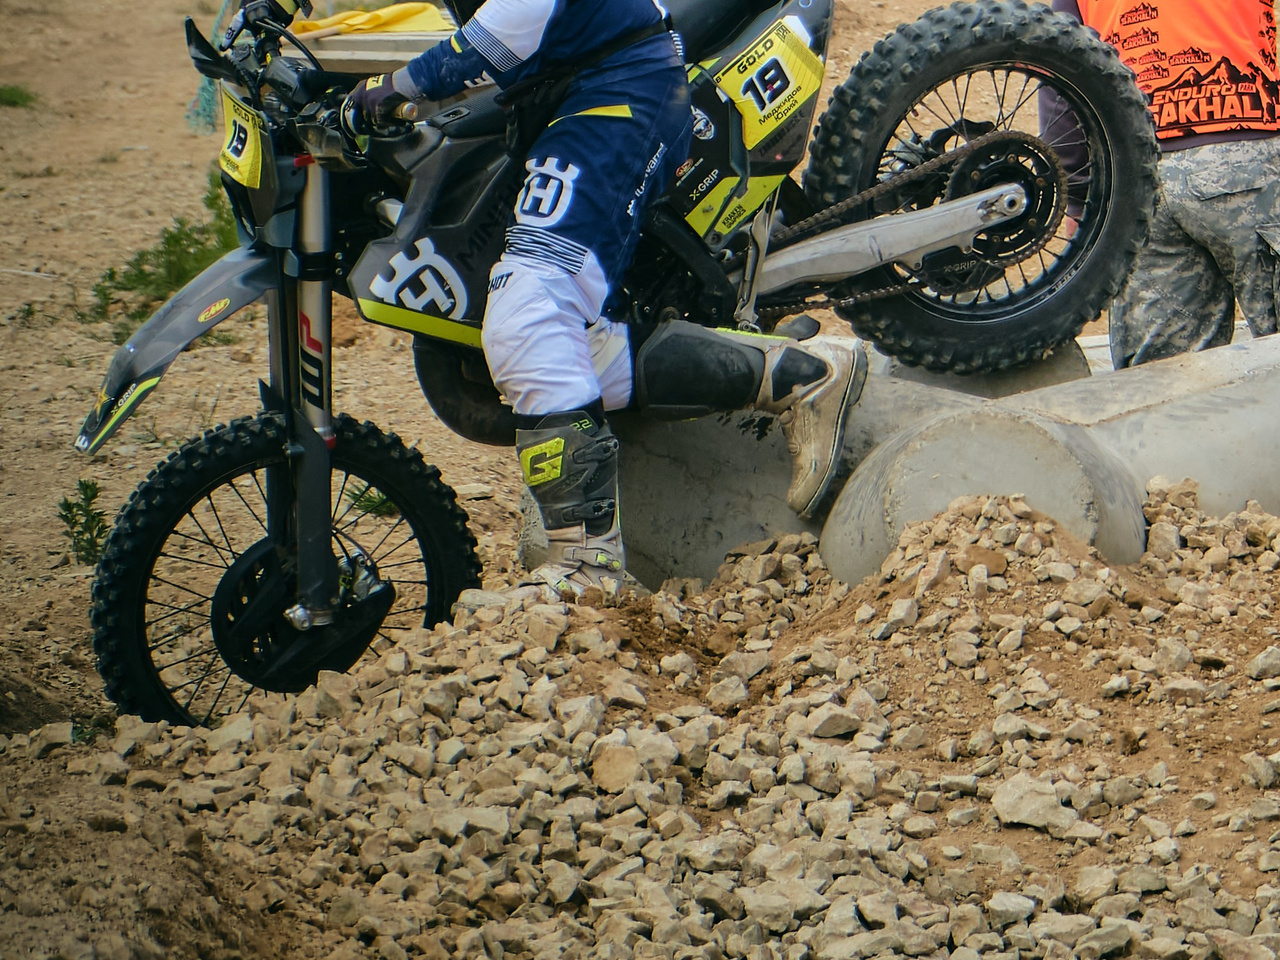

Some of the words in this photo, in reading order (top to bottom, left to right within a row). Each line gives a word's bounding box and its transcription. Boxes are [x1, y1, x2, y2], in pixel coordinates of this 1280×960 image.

[736, 38, 775, 75] GOLD
[741, 57, 792, 113] 19
[1152, 82, 1237, 106] ENDURO
[773, 99, 799, 122] Юрий
[688, 168, 720, 201] X-GRIP
